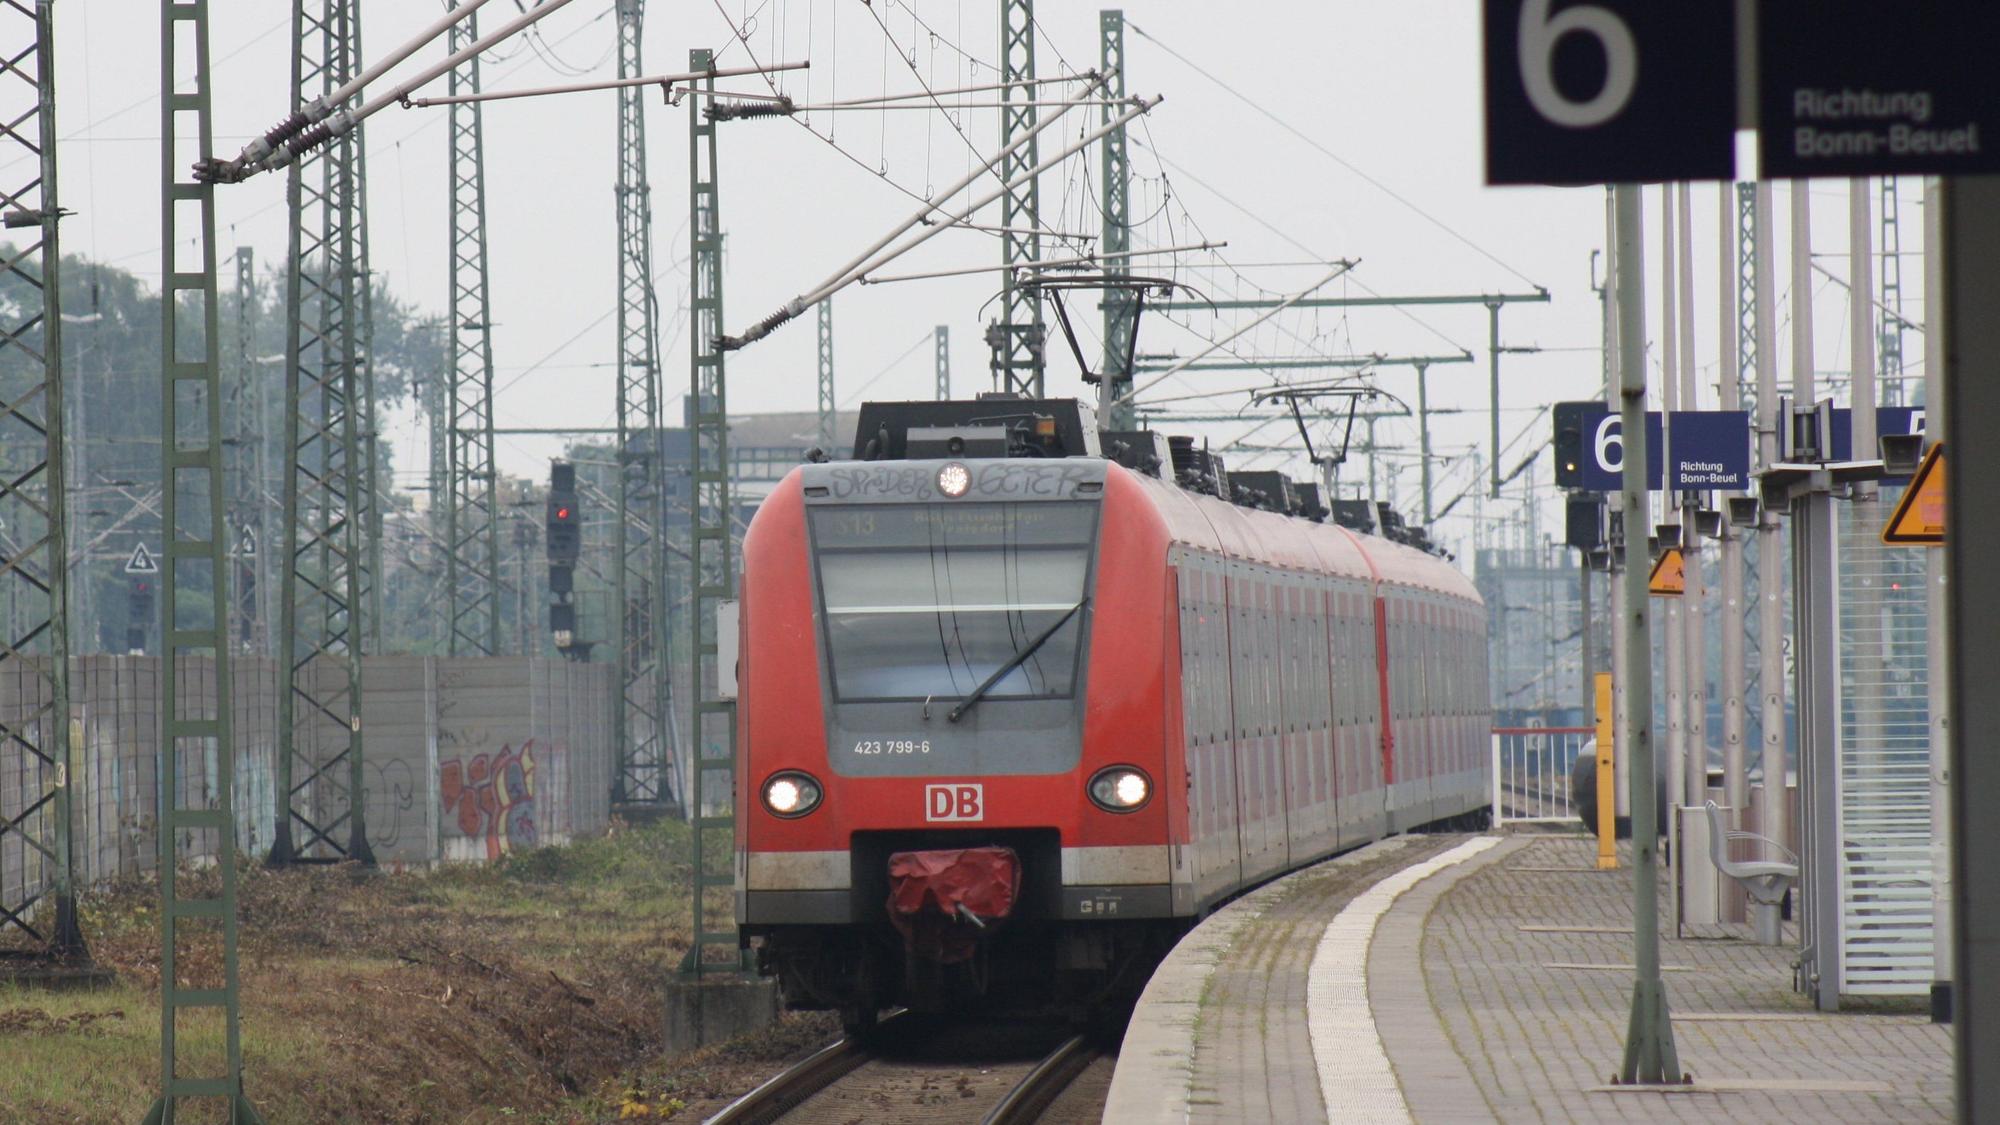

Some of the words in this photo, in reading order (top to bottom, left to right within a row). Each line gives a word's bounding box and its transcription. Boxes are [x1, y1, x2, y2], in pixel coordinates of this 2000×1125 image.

[1518, 0, 1639, 128] 6
[1795, 88, 1931, 121] Richtung
[1795, 123, 1979, 156] Bonn-Beuel
[1594, 414, 1624, 473] 6
[1680, 461, 1724, 472] Richtung
[1680, 473, 1738, 484] Bonn-Beuel
[135, 553, 146, 568] 4
[854, 741, 881, 754] 423
[886, 740, 930, 754] 799-6
[929, 786, 980, 818] DB
